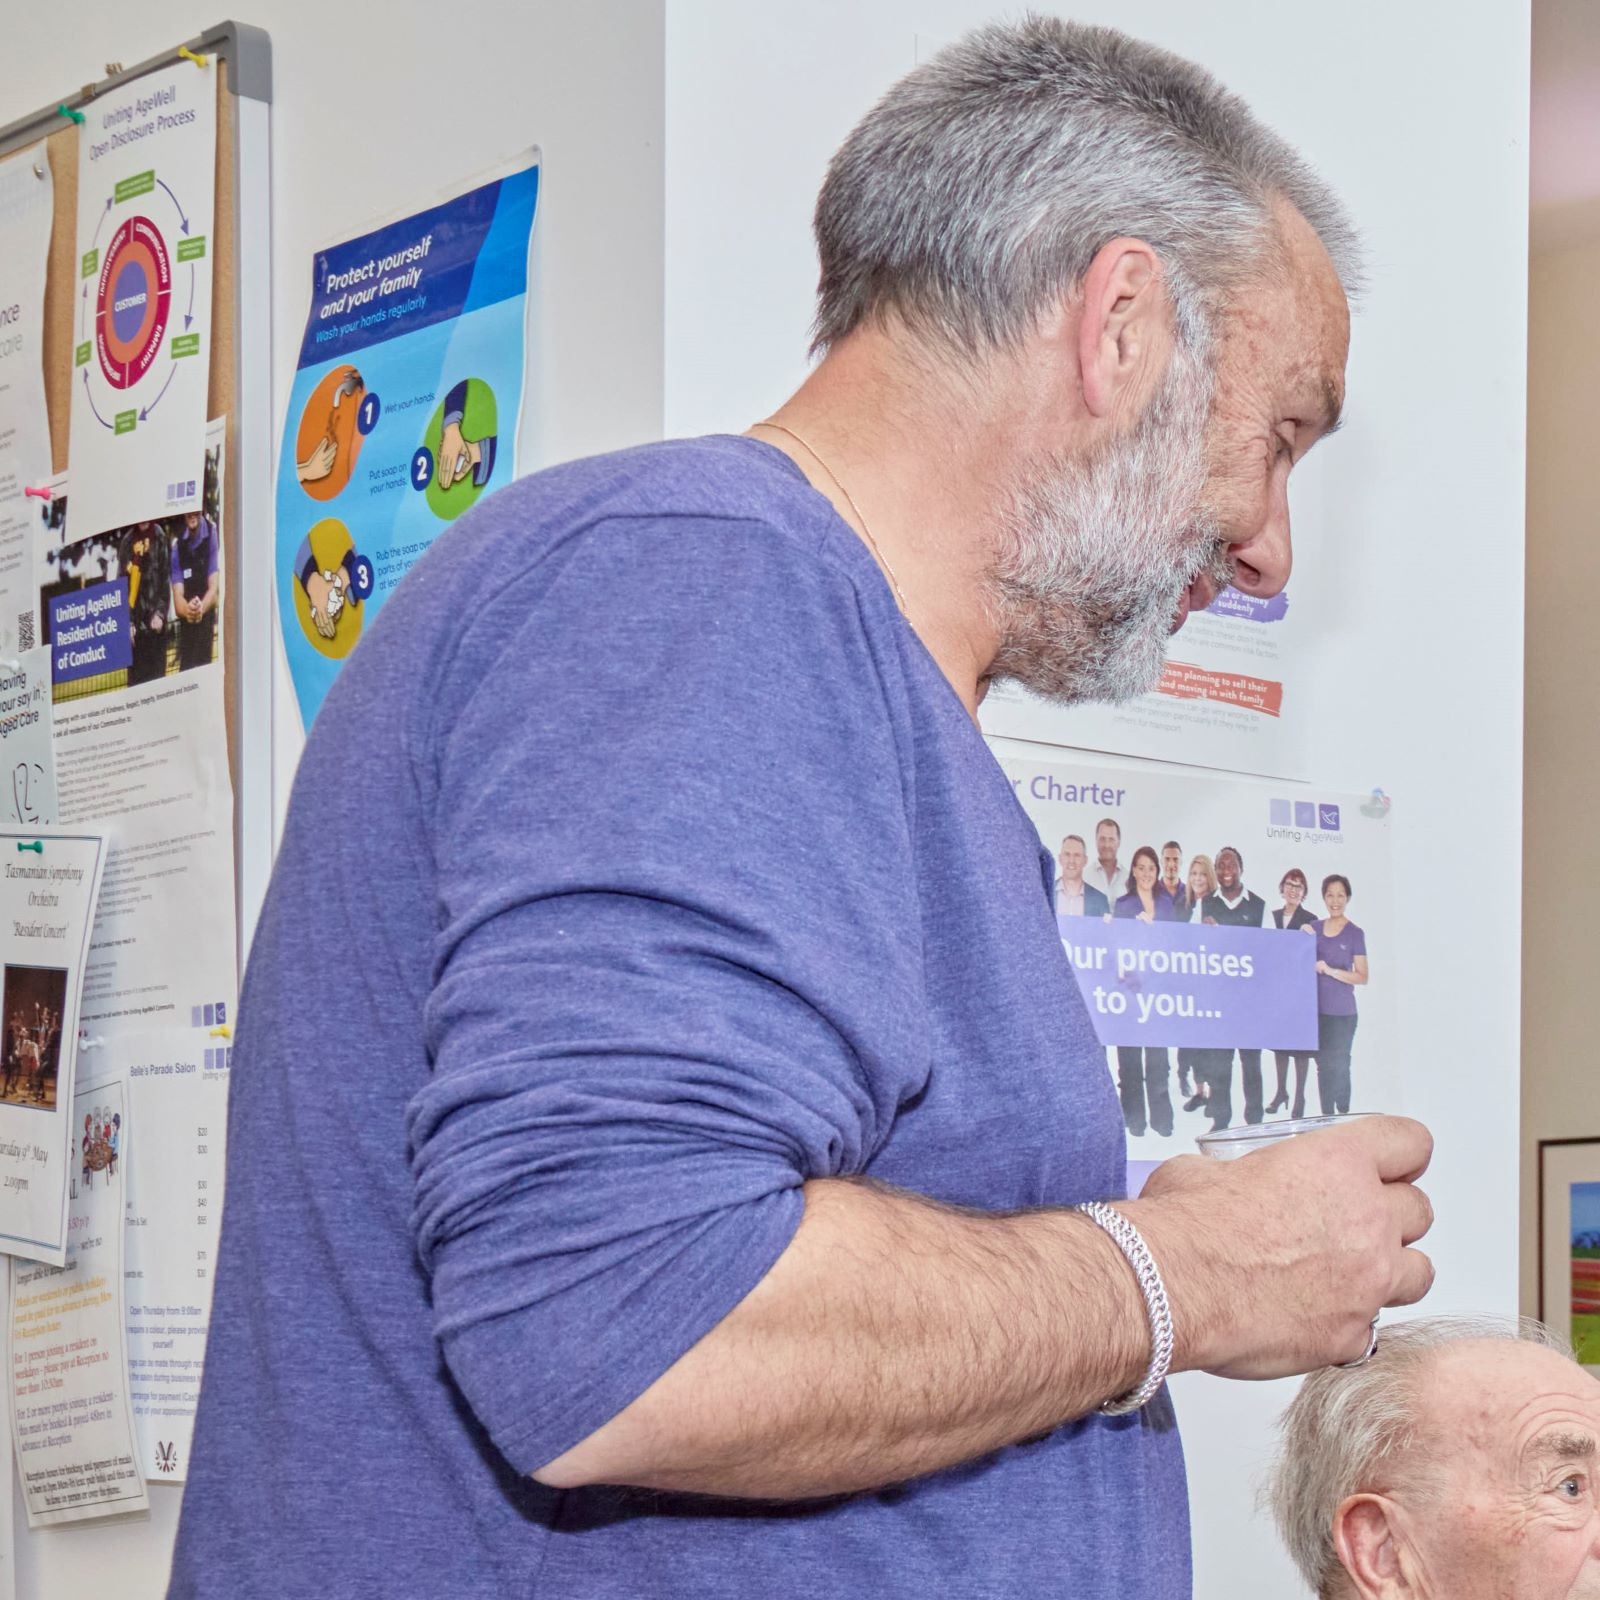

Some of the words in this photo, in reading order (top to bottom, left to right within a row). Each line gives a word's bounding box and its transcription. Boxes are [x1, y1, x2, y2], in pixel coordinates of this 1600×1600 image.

[103, 106, 132, 129] Uniting
[136, 85, 176, 116] AgeWell
[90, 142, 109, 160] Open
[111, 122, 155, 149] Disclosure
[157, 109, 196, 130] Process
[326, 260, 375, 294] Protect
[376, 235, 432, 278] yourself
[115, 293, 147, 312] CUSTOMER
[320, 293, 347, 319] and
[347, 286, 378, 313] your
[379, 267, 422, 296] family
[316, 325, 338, 343] Wash
[340, 320, 359, 337] your
[360, 309, 386, 328] hands
[388, 295, 427, 318] regularly
[141, 324, 163, 369] EMPATHY
[365, 402, 373, 425] 1
[384, 403, 398, 415] Wet
[399, 399, 414, 413] your
[369, 469, 381, 481] Put
[381, 466, 398, 478] soap
[399, 463, 407, 472] on
[417, 456, 428, 481] 2
[370, 483, 385, 496] your
[376, 549, 390, 561] Rub
[390, 545, 401, 558] the
[401, 541, 418, 556] soap
[358, 565, 369, 589] 3
[378, 563, 396, 578] parts
[396, 560, 404, 572] of
[379, 579, 387, 590] at
[56, 600, 86, 623] Uniting
[87, 589, 122, 617] AgeWell
[1218, 599, 1255, 616] suddenly
[57, 624, 94, 647] Resident
[95, 618, 118, 638] Code
[57, 654, 69, 670] of
[69, 644, 106, 667] Conduct
[1164, 668, 1182, 677] rson
[1184, 670, 1220, 688] planning
[1221, 677, 1230, 687] to
[1232, 678, 1246, 690] sell
[1248, 680, 1268, 693] their
[17, 692, 32, 708] say
[33, 685, 41, 700] in
[1160, 680, 1176, 689] and
[1177, 682, 1207, 698] moving
[1209, 687, 1218, 697] in
[1219, 688, 1238, 701] with
[1239, 690, 1265, 707] family
[19, 709, 39, 727] Care
[1030, 775, 1125, 806] Charter
[1266, 827, 1301, 843] Uniting
[1303, 830, 1344, 846] AgeWell
[5, 862, 48, 880] Tasmanian
[48, 863, 85, 886] Symphony
[28, 889, 59, 907] Orchestra
[1118, 944, 1254, 979] promises
[1093, 986, 1127, 1014] to
[1136, 992, 1222, 1023] you...
[130, 1065, 149, 1078] Belle's
[150, 1063, 174, 1076] Parade
[175, 1061, 196, 1075] Salon
[31, 1144, 48, 1168] May
